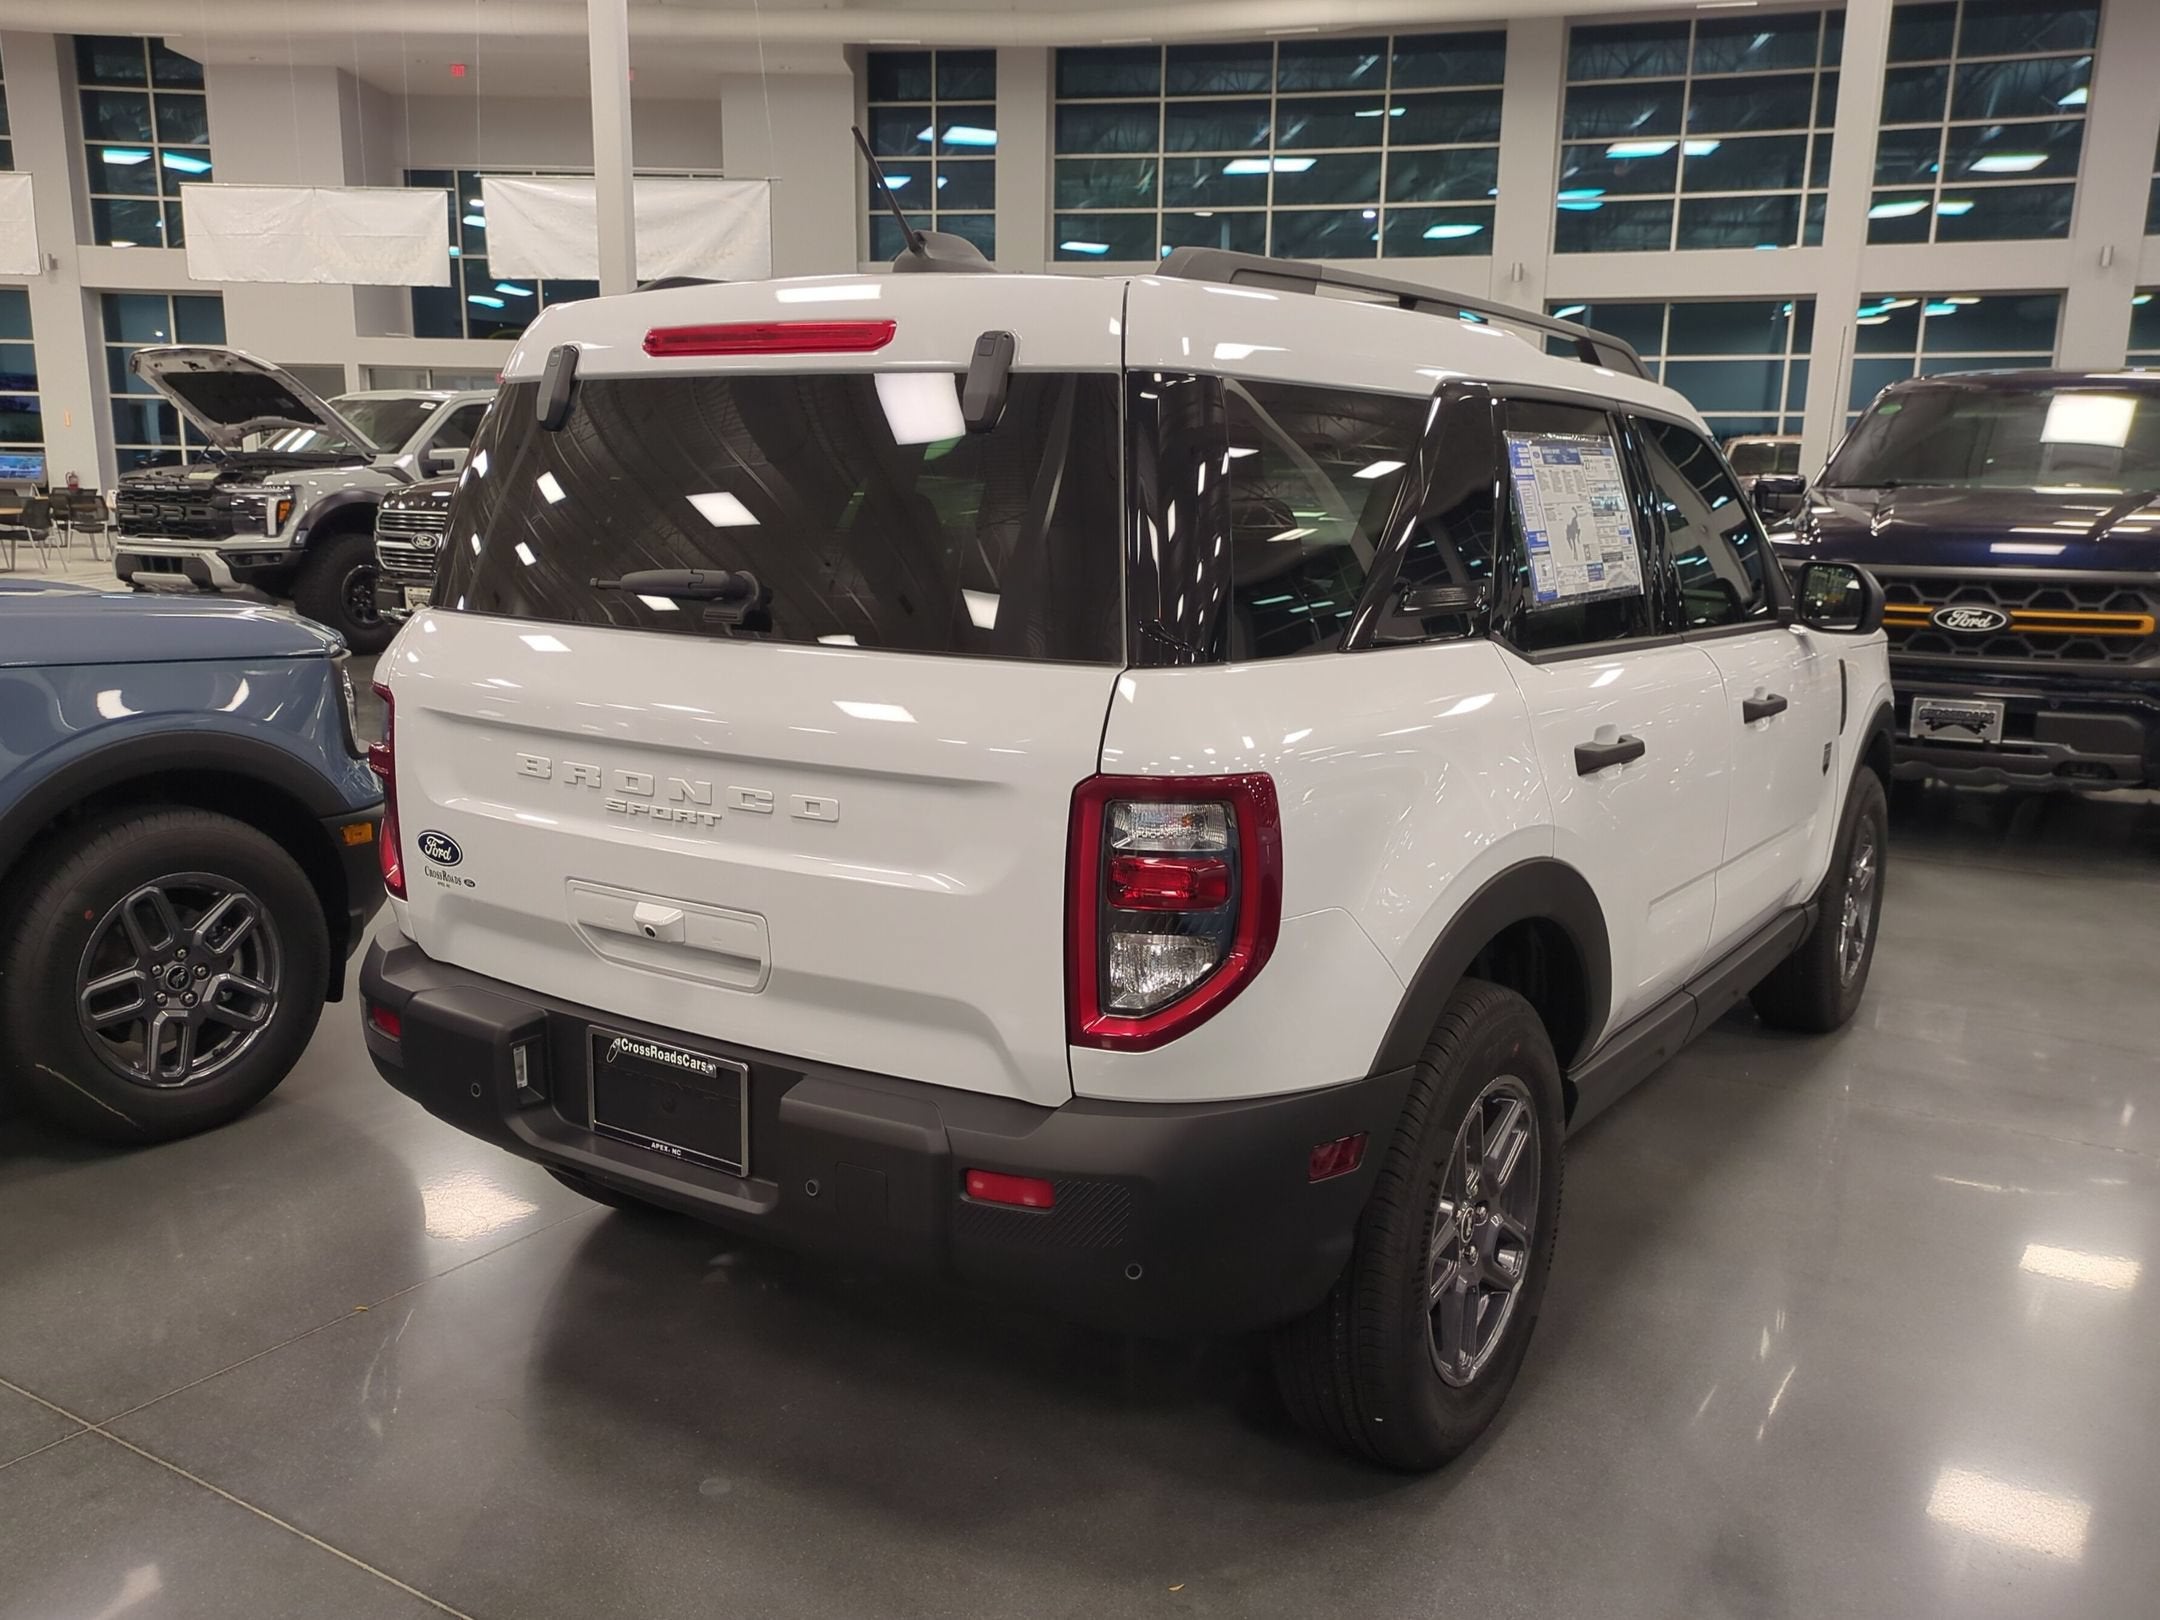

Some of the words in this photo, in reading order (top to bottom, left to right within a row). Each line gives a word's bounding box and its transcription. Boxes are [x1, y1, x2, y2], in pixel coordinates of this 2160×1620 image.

[1946, 609, 1992, 629] Ford
[515, 752, 840, 823] BRONCO
[604, 797, 723, 826] SPORT
[424, 835, 453, 861] Ford
